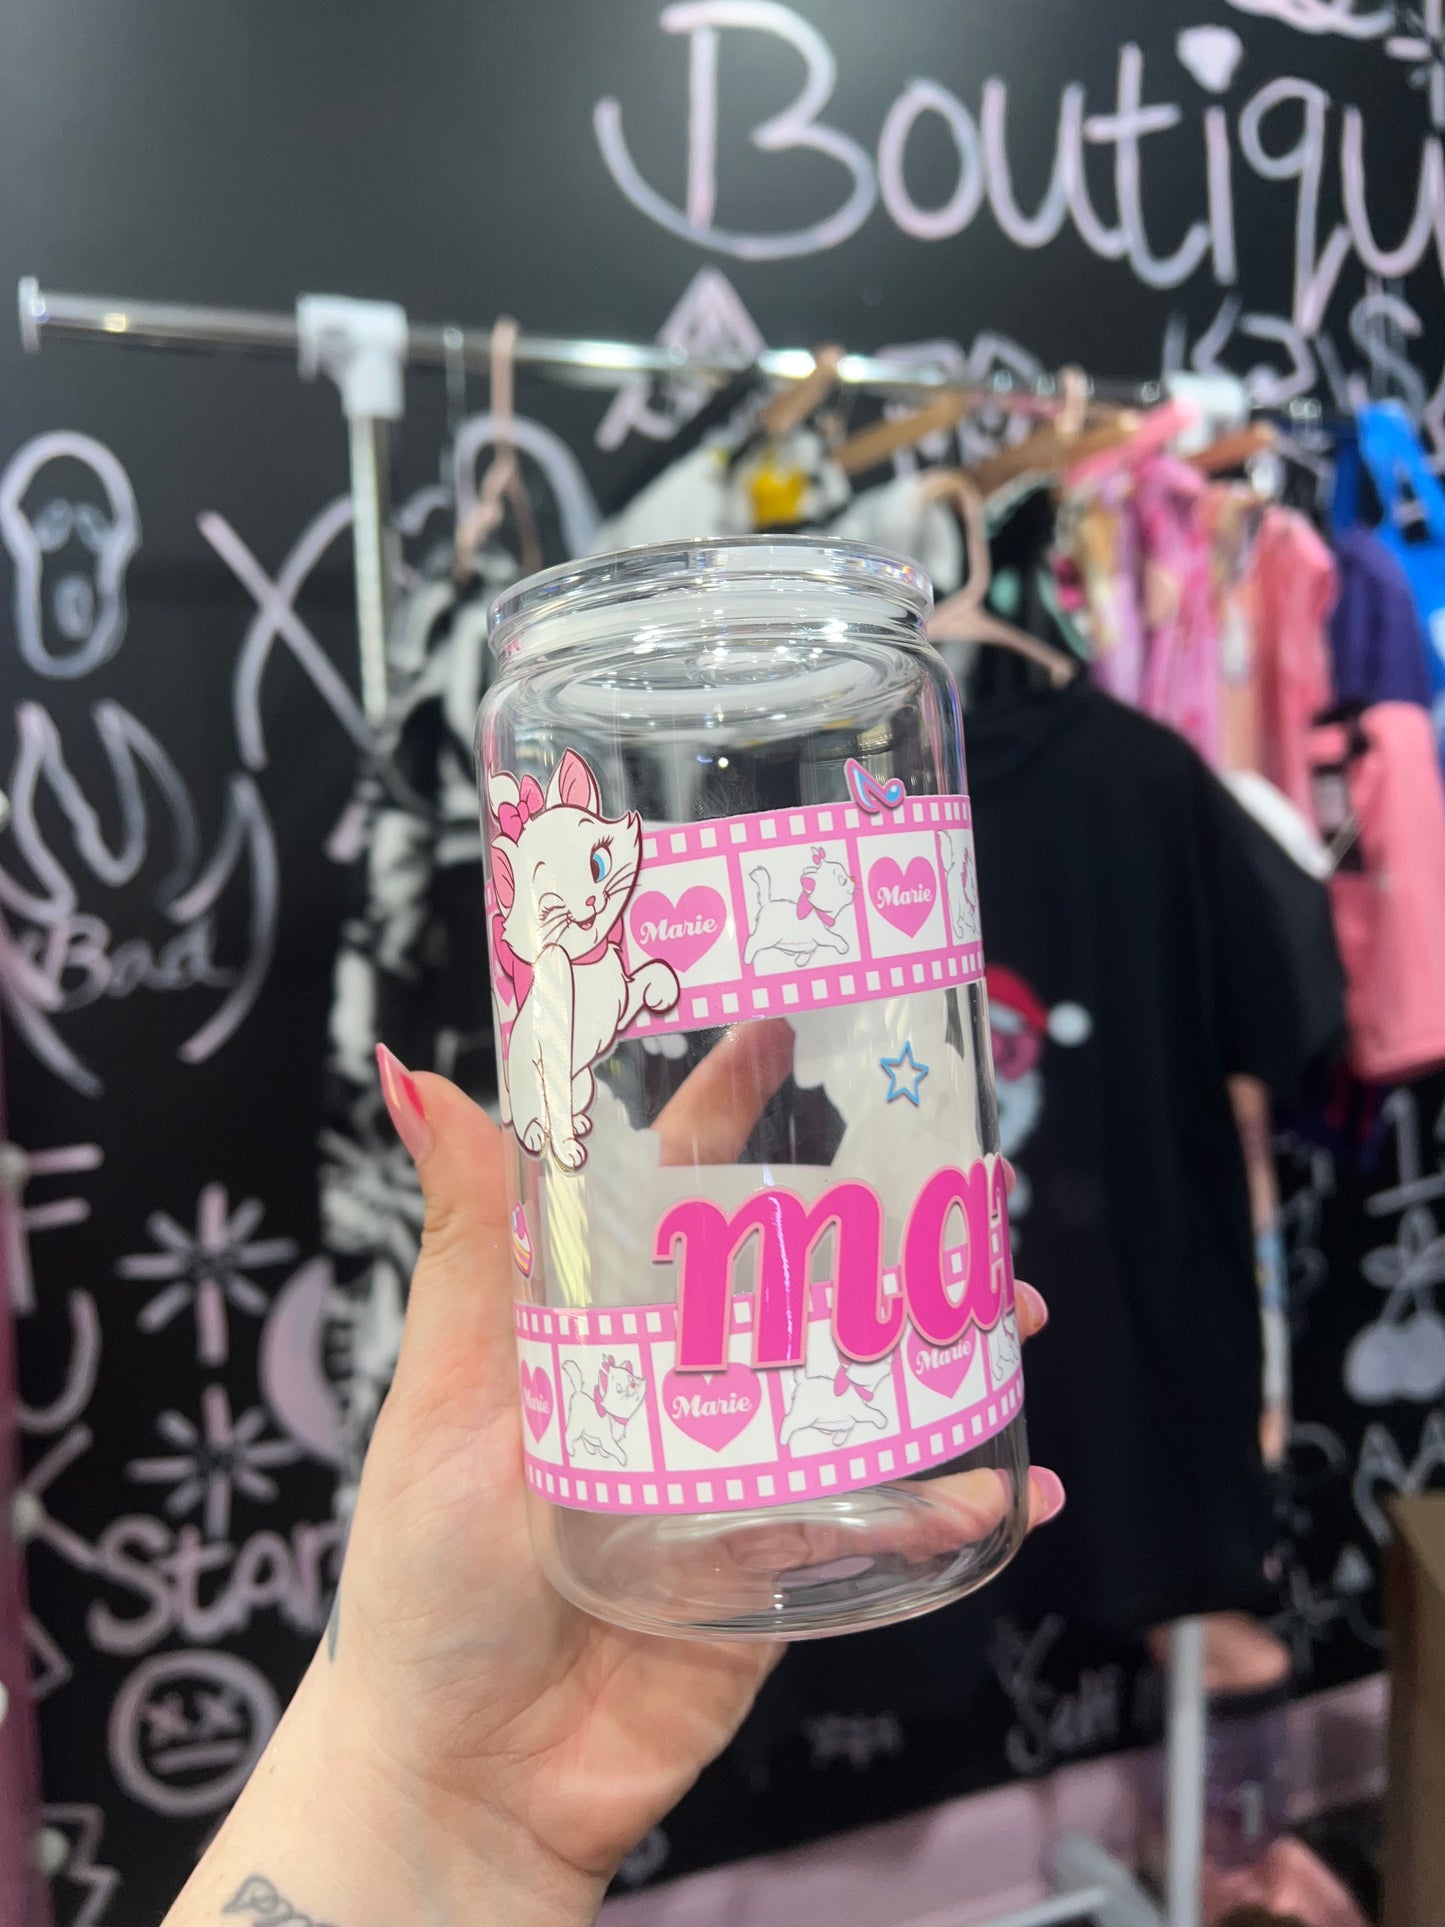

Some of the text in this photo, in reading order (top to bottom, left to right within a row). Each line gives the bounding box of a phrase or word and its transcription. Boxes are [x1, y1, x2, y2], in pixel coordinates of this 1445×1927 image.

[876, 883, 933, 910] Marie
[640, 914, 718, 945] Marie
[914, 1340, 972, 1376] Marie
[671, 1392, 753, 1420] Marie
